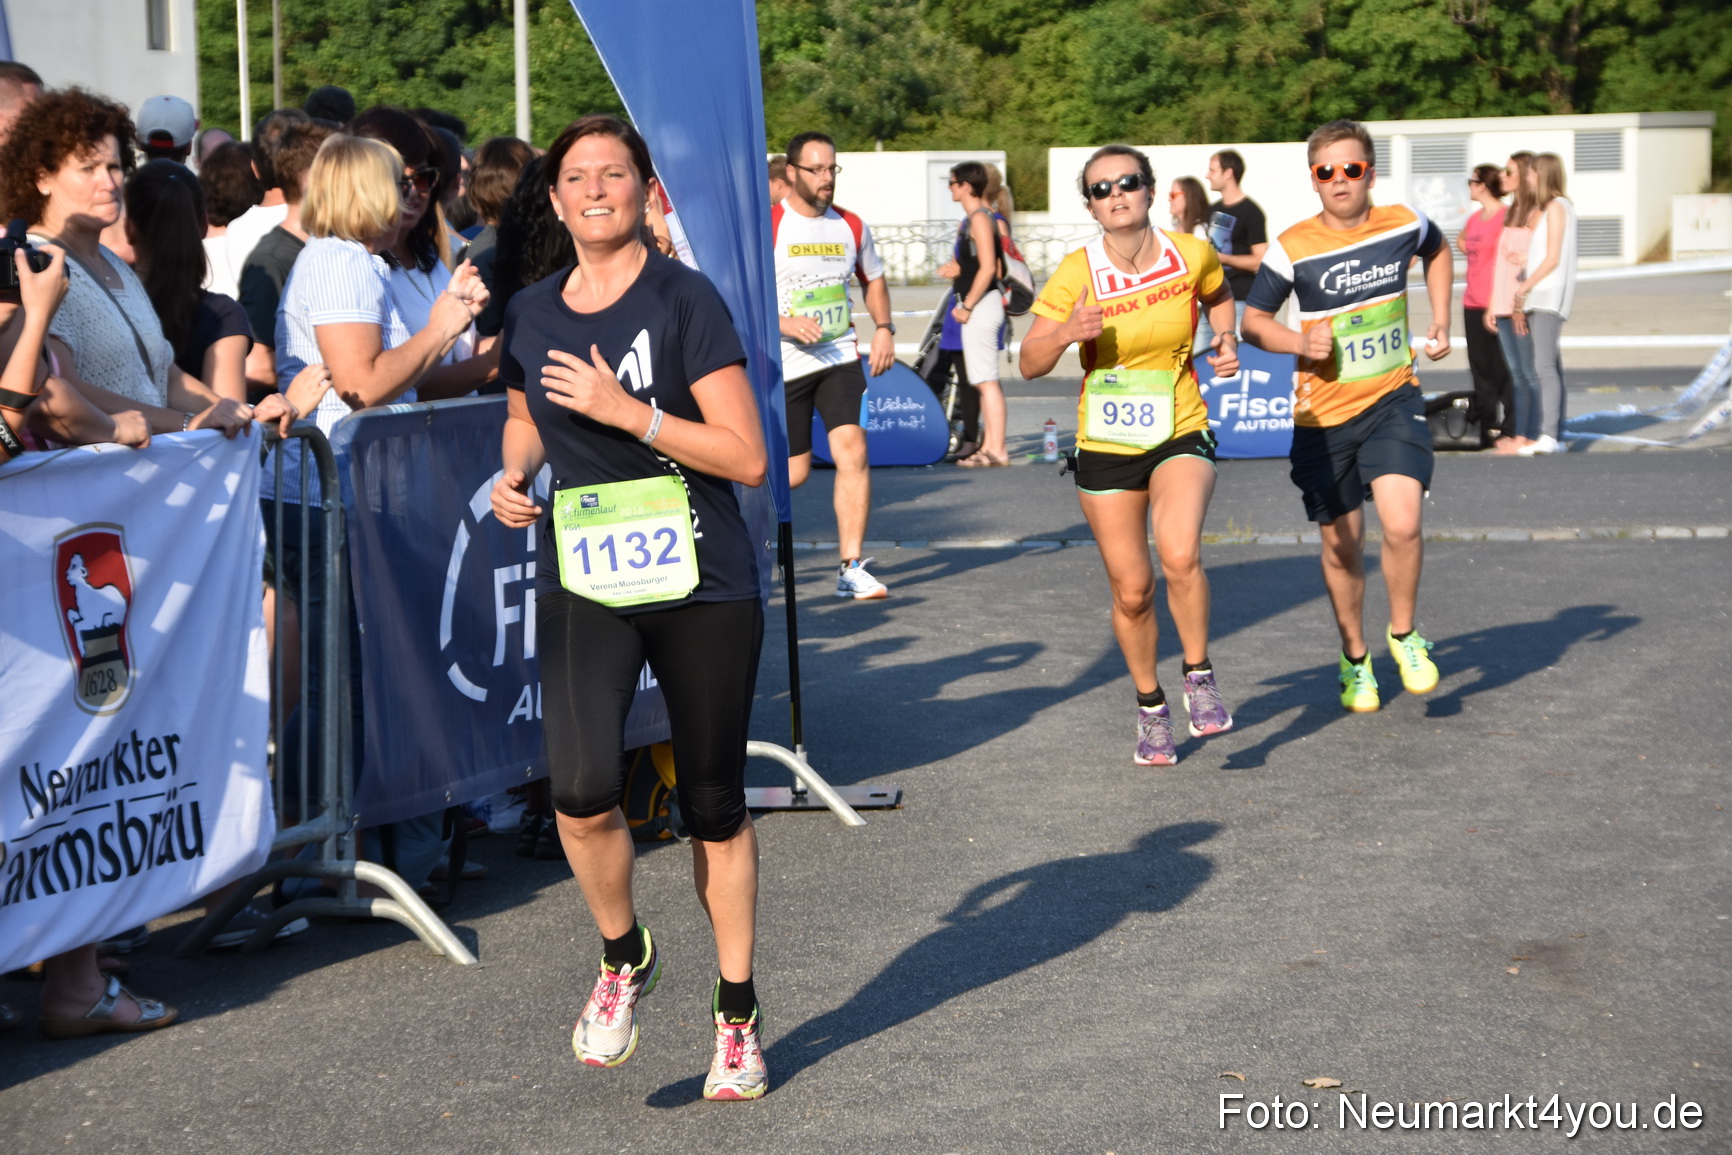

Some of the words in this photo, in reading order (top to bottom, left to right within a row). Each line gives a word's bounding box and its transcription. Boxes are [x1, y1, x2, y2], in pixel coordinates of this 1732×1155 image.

[791, 244, 841, 255] ONLINE
[1336, 260, 1401, 290] Fischer
[1344, 274, 1399, 295] AUTOMOBILE
[1102, 298, 1141, 318] MAX
[1145, 281, 1192, 306] BÖGL
[1344, 327, 1402, 363] 1518
[1103, 401, 1155, 427] 938
[574, 504, 616, 517] firmenlauf
[572, 527, 681, 575] 1132
[590, 582, 618, 591] Verena
[619, 576, 668, 588] Moosburger
[83, 667, 117, 698] 1628
